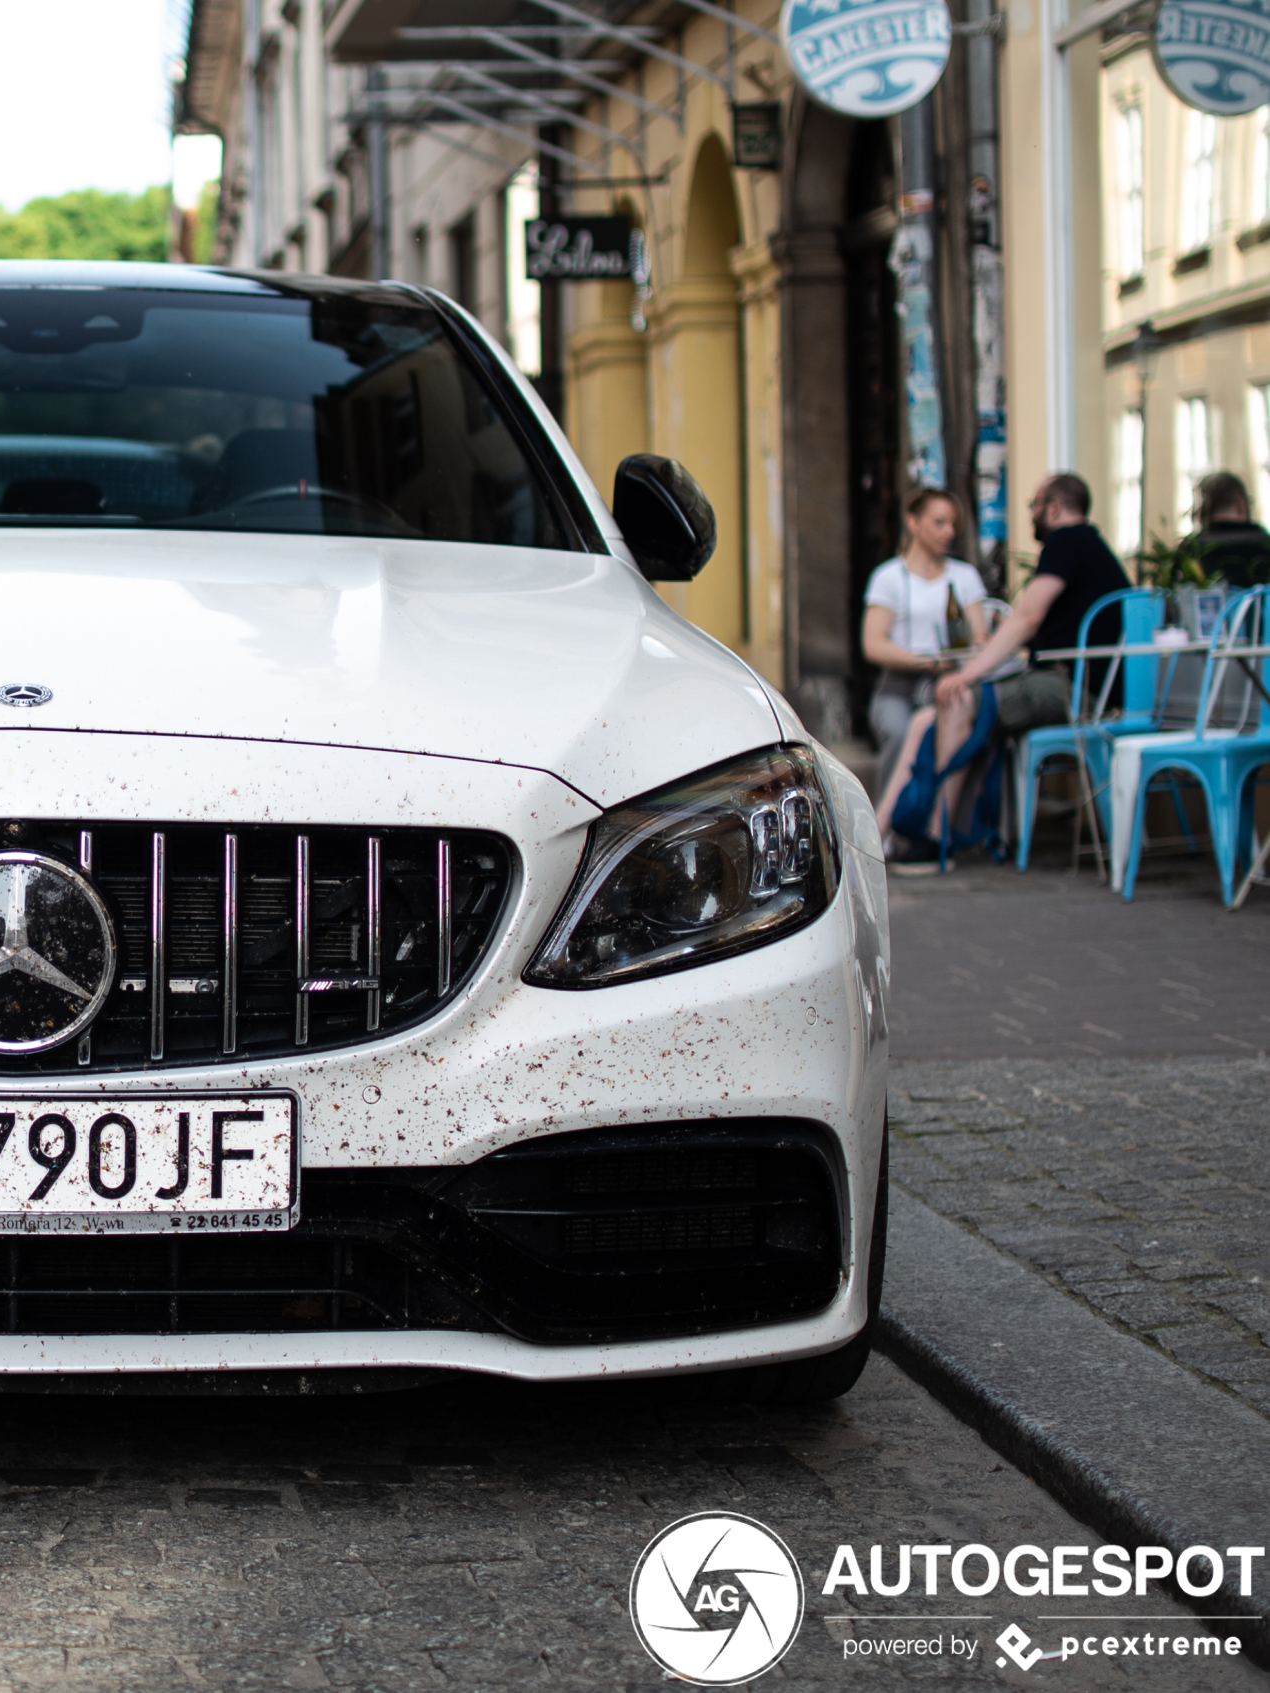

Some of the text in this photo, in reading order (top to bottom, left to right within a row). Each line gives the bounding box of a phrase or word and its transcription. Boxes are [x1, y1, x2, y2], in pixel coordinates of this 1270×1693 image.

[794, 8, 948, 73] CAKESTER
[327, 979, 379, 990] AMG
[187, 1213, 283, 1229] 22 641 45 45
